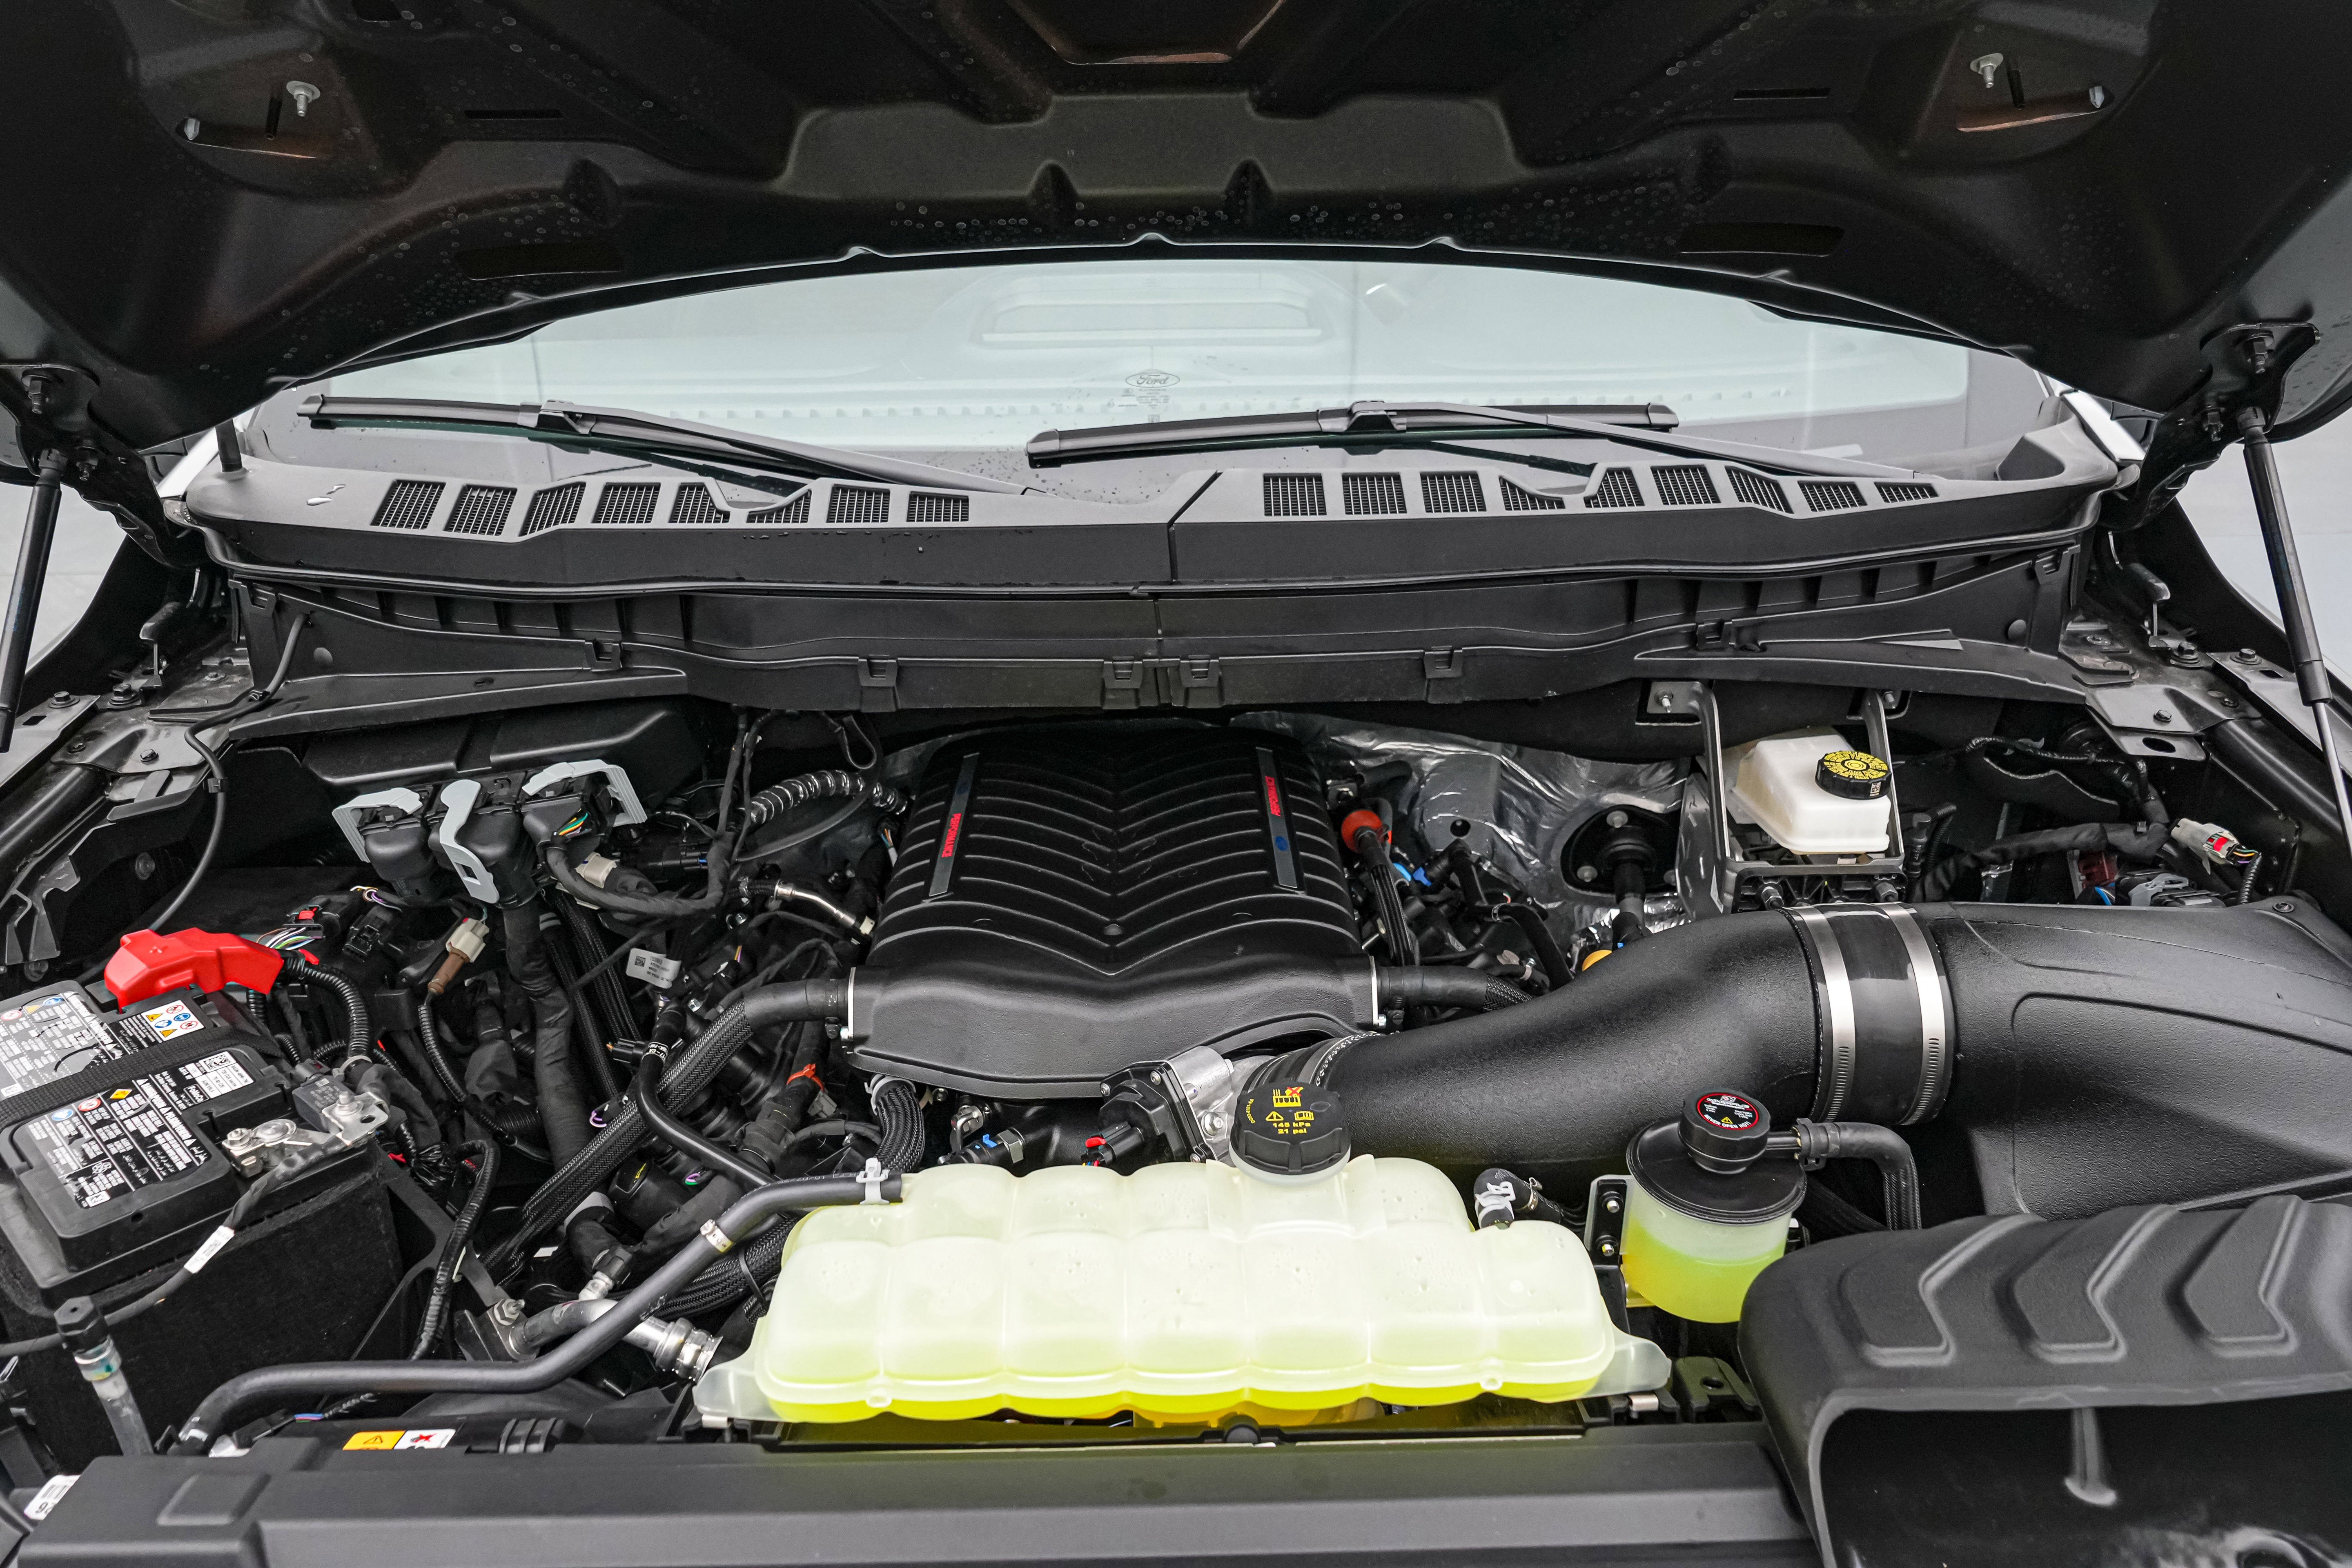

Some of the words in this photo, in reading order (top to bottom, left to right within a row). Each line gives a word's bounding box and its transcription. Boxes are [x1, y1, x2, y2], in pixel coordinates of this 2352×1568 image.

[1136, 374, 1169, 385] Ford
[1265, 776, 1281, 816] PERFORMANCE
[941, 813, 962, 858] PERFORMANCE
[187, 1086, 204, 1102] FoMoCo
[1704, 1114, 1721, 1126] NEVER
